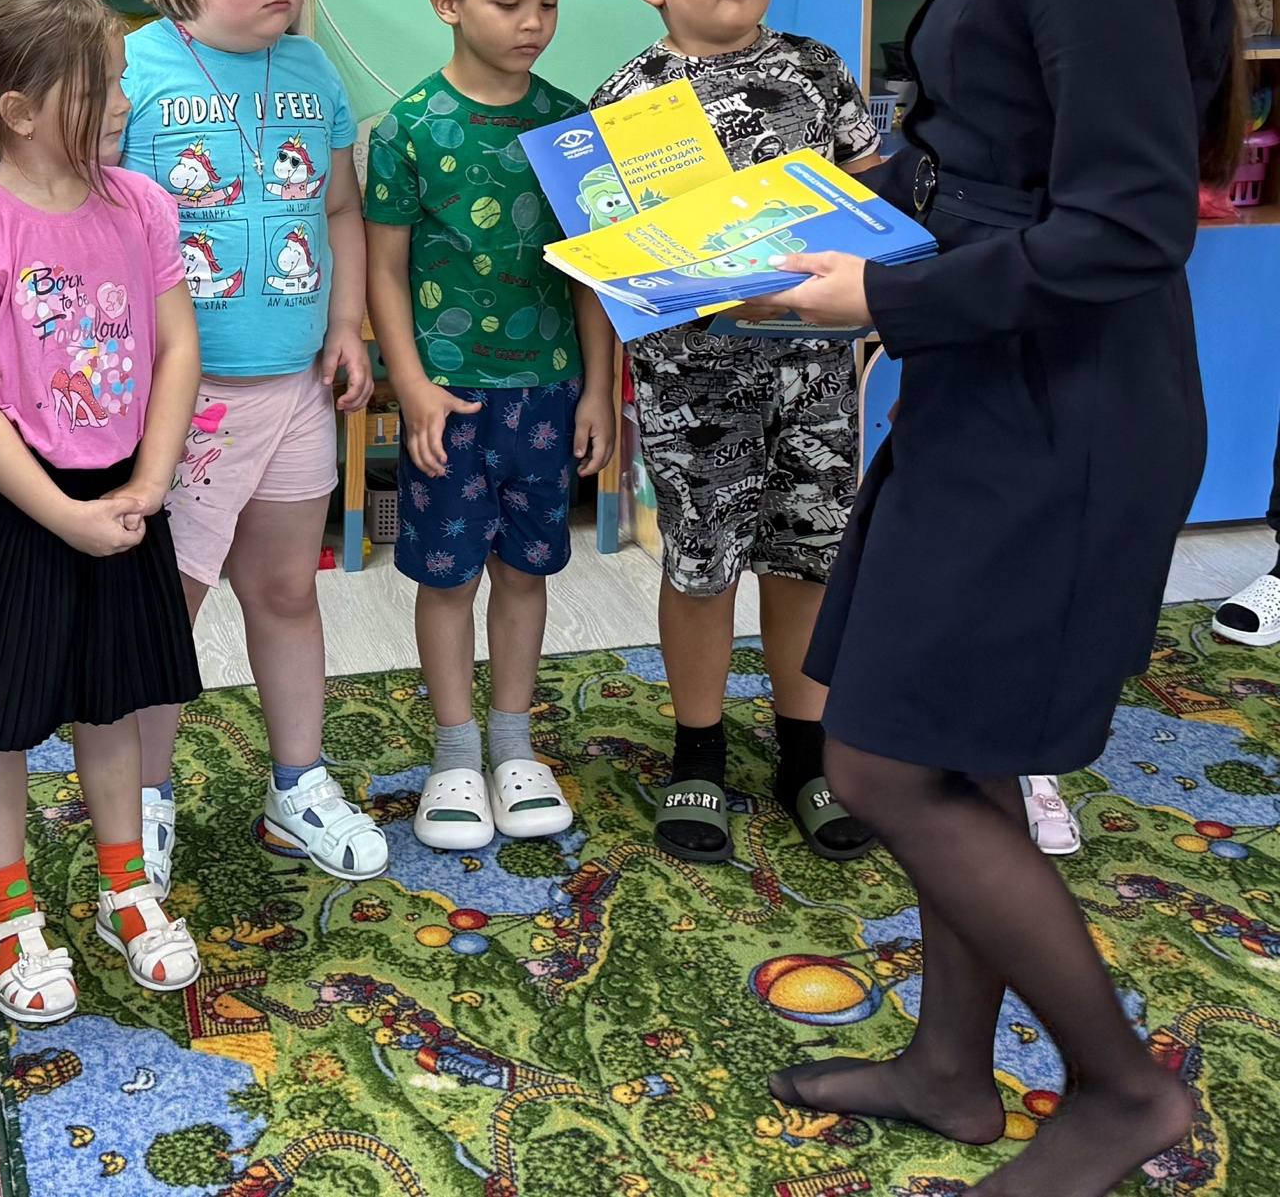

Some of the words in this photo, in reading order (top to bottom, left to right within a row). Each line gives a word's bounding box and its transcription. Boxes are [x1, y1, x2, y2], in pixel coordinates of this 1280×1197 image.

[158, 92, 239, 127] TODAY
[253, 92, 264, 120] I
[619, 148, 665, 169] ИСТОРИЯ
[665, 145, 673, 153] О
[623, 164, 644, 177] КАК
[646, 160, 658, 171] НЕ
[659, 145, 703, 166] СОЗДАТЬ
[628, 155, 706, 186] МОНСТРОФОНА
[20, 267, 85, 296] Born
[59, 293, 73, 311] to
[204, 300, 228, 311] STAR
[267, 297, 281, 307] AN
